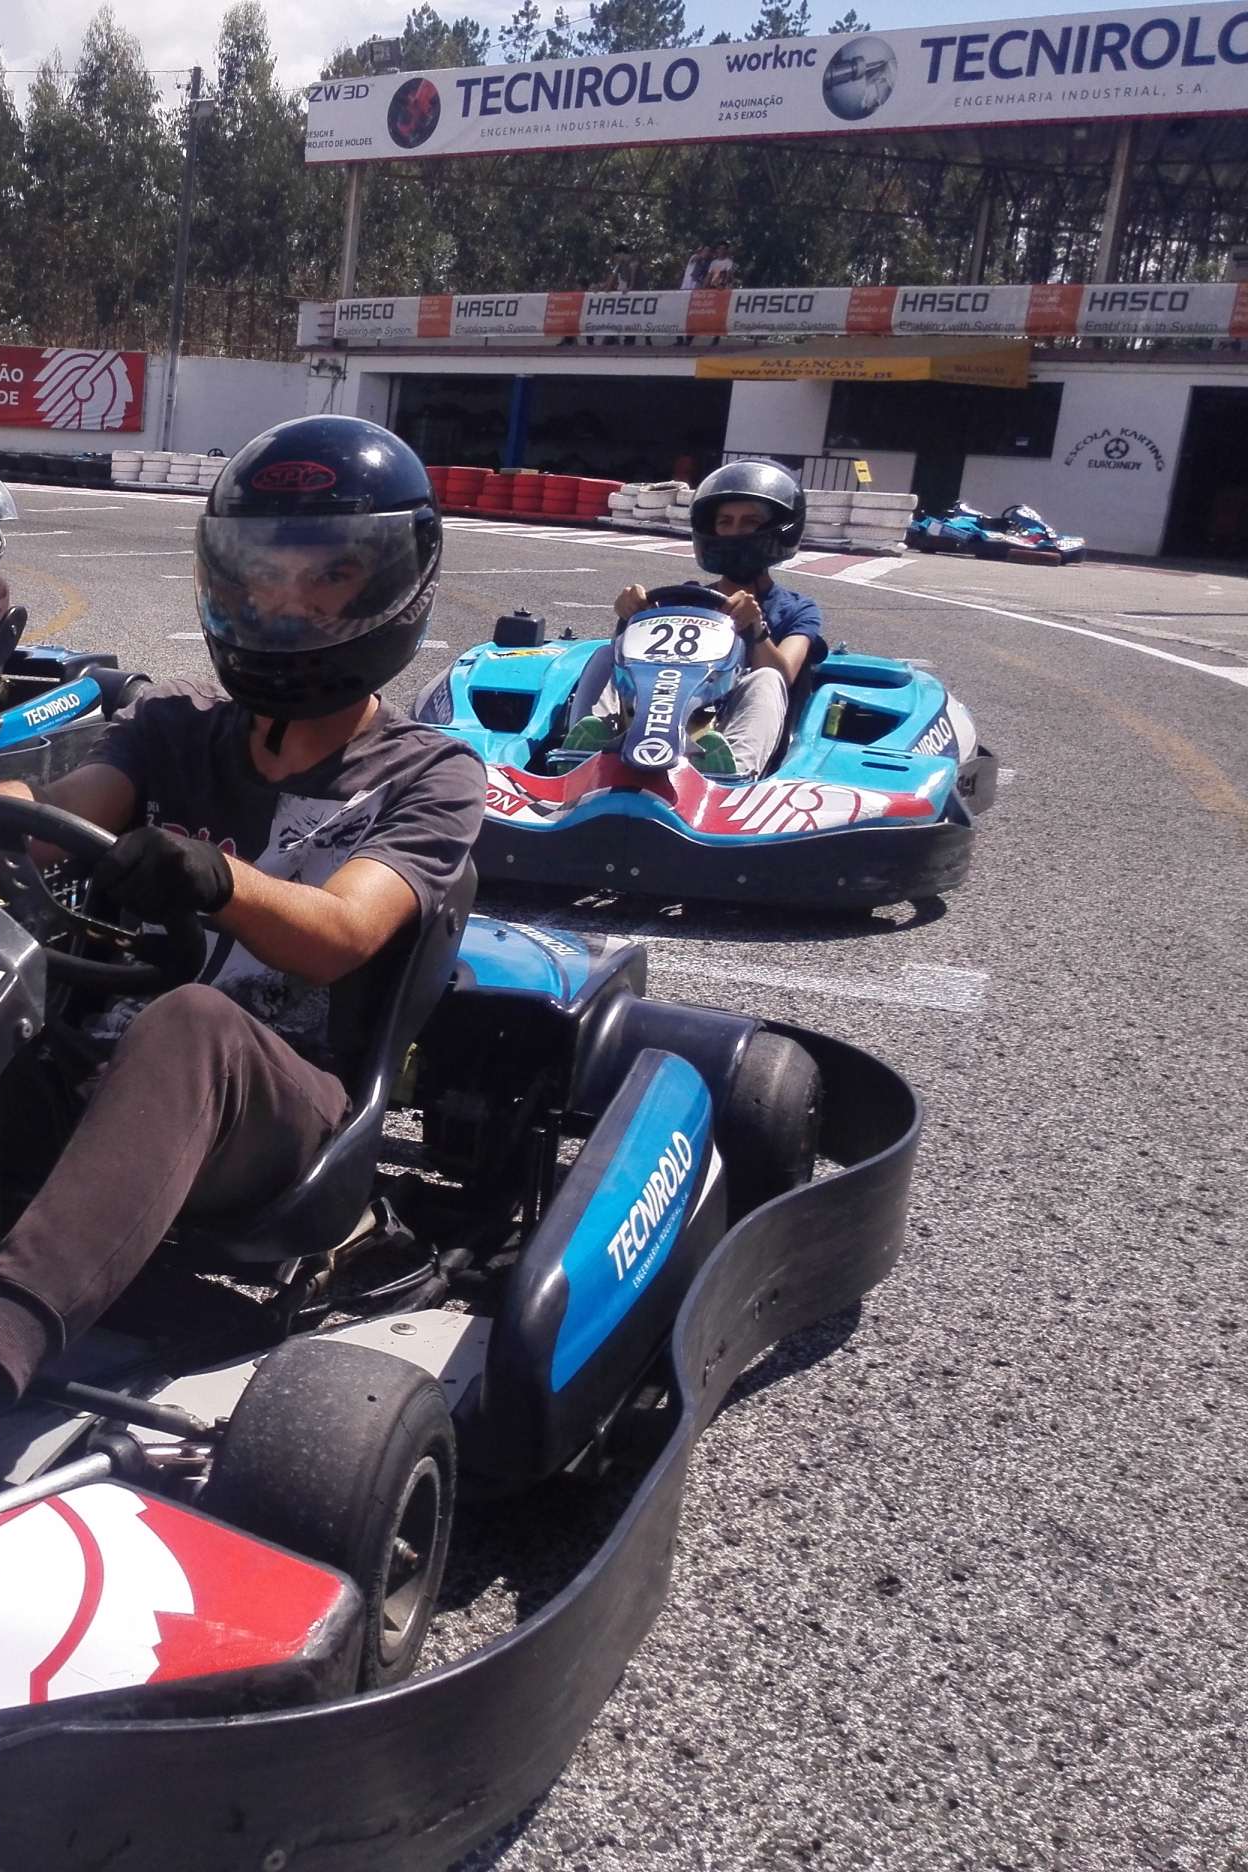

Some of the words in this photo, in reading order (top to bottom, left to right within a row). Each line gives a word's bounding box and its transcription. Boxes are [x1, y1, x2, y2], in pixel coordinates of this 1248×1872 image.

[920, 12, 1248, 83] TECNIROLO
[726, 44, 817, 73] worknc
[309, 84, 370, 102] ZW3D
[456, 57, 700, 118] TECNIROLO
[954, 91, 1053, 108] ENGENHARIA
[1176, 83, 1208, 95] S.A.
[719, 95, 784, 109] MAQUINAÇÃO
[741, 110, 768, 120] EIXOS
[480, 124, 551, 138] ENGENHARIA
[345, 138, 373, 147] MOLDES
[456, 300, 519, 318] HASCO
[587, 298, 659, 315] HASCO
[735, 295, 815, 313] HASCO
[901, 293, 990, 312] HASCO
[1088, 291, 1190, 312] HASCO
[339, 303, 394, 321] HASCO
[1120, 427, 1165, 472] KARTING
[639, 617, 720, 629] EUROINDY
[643, 623, 701, 656] 28
[22, 693, 81, 727] TECNIROLO
[607, 1131, 692, 1281] TECNIROLO
